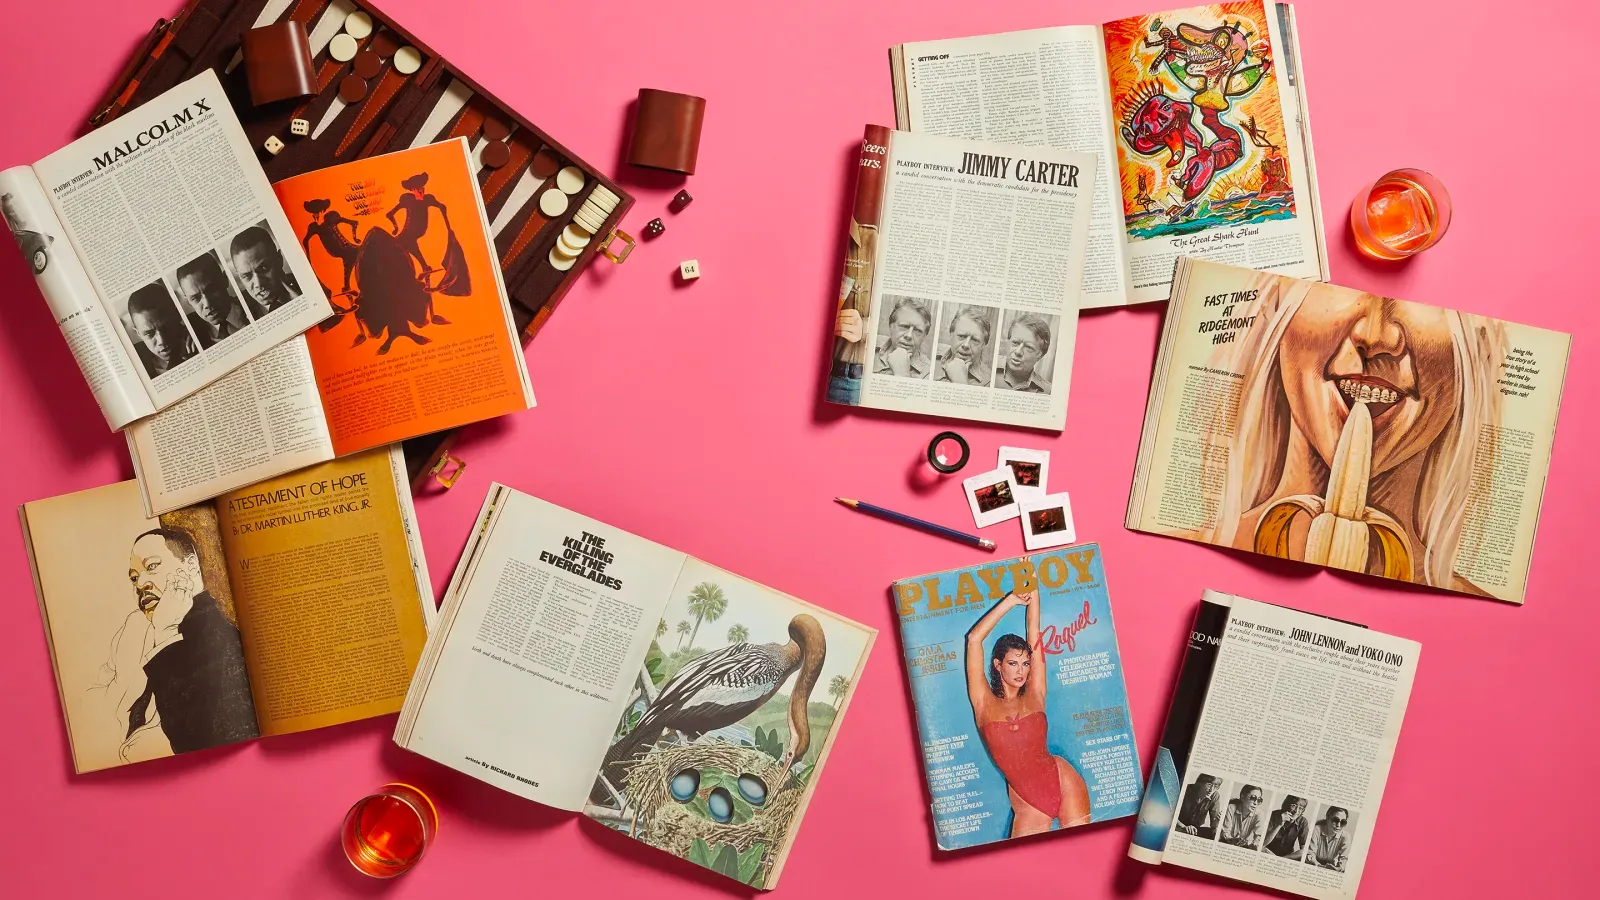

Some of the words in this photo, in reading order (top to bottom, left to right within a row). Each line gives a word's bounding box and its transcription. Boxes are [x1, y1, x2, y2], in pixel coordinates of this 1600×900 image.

[53, 181, 71, 194] PLAYBOY
[93, 108, 193, 171] MALCOLM
[193, 98, 211, 115] X
[958, 153, 1011, 179] JIMMY
[1016, 160, 1079, 187] CARTER
[1170, 239, 1187, 248] The
[1190, 236, 1210, 247] Great
[1212, 232, 1234, 242] Shark
[1236, 228, 1258, 238] Hunt
[1204, 294, 1228, 307] FAST
[1231, 290, 1258, 303] TIMES
[1223, 305, 1235, 317] AT
[1199, 316, 1256, 333] RIDGEMONT
[1213, 332, 1235, 345] HIGH
[1513, 348, 1525, 356] being
[1230, 373, 1245, 381] CROWE
[229, 501, 236, 512] A
[234, 485, 306, 511] TESTAMENT
[310, 481, 327, 495] OF
[332, 473, 367, 491] HOPE
[255, 515, 292, 531] MARTIN
[294, 507, 331, 523] LUTHER
[361, 499, 372, 509] JR.
[581, 531, 605, 549] THE
[563, 536, 614, 564] KILLING
[563, 549, 581, 561] OF
[582, 555, 606, 573] THE
[540, 551, 622, 590] EVERGLADES
[895, 549, 1095, 616] PLAYBOY
[900, 609, 953, 625] ENTERTAINMENT
[1034, 601, 1098, 663] Raquel
[918, 644, 943, 656] GALA
[1231, 618, 1255, 629] PLAYBOY
[1289, 628, 1312, 643] JOHN
[1312, 633, 1346, 652] LENNON
[1345, 645, 1360, 656] and
[1361, 646, 1383, 661] YOKO
[1385, 652, 1402, 666] ONO
[1060, 660, 1100, 672] CELEBRATION
[1064, 652, 1109, 664] PHOTOGRAPHIC
[1062, 676, 1087, 685] DESIRED
[1089, 671, 1112, 680] WOMAN
[1069, 667, 1097, 677] DECADE'S
[1098, 664, 1116, 672] MOST
[491, 766, 515, 778] RICHARD
[516, 776, 538, 787] RHODES
[1095, 770, 1117, 779] RICHARD
[1094, 800, 1116, 809] HOLIDAY
